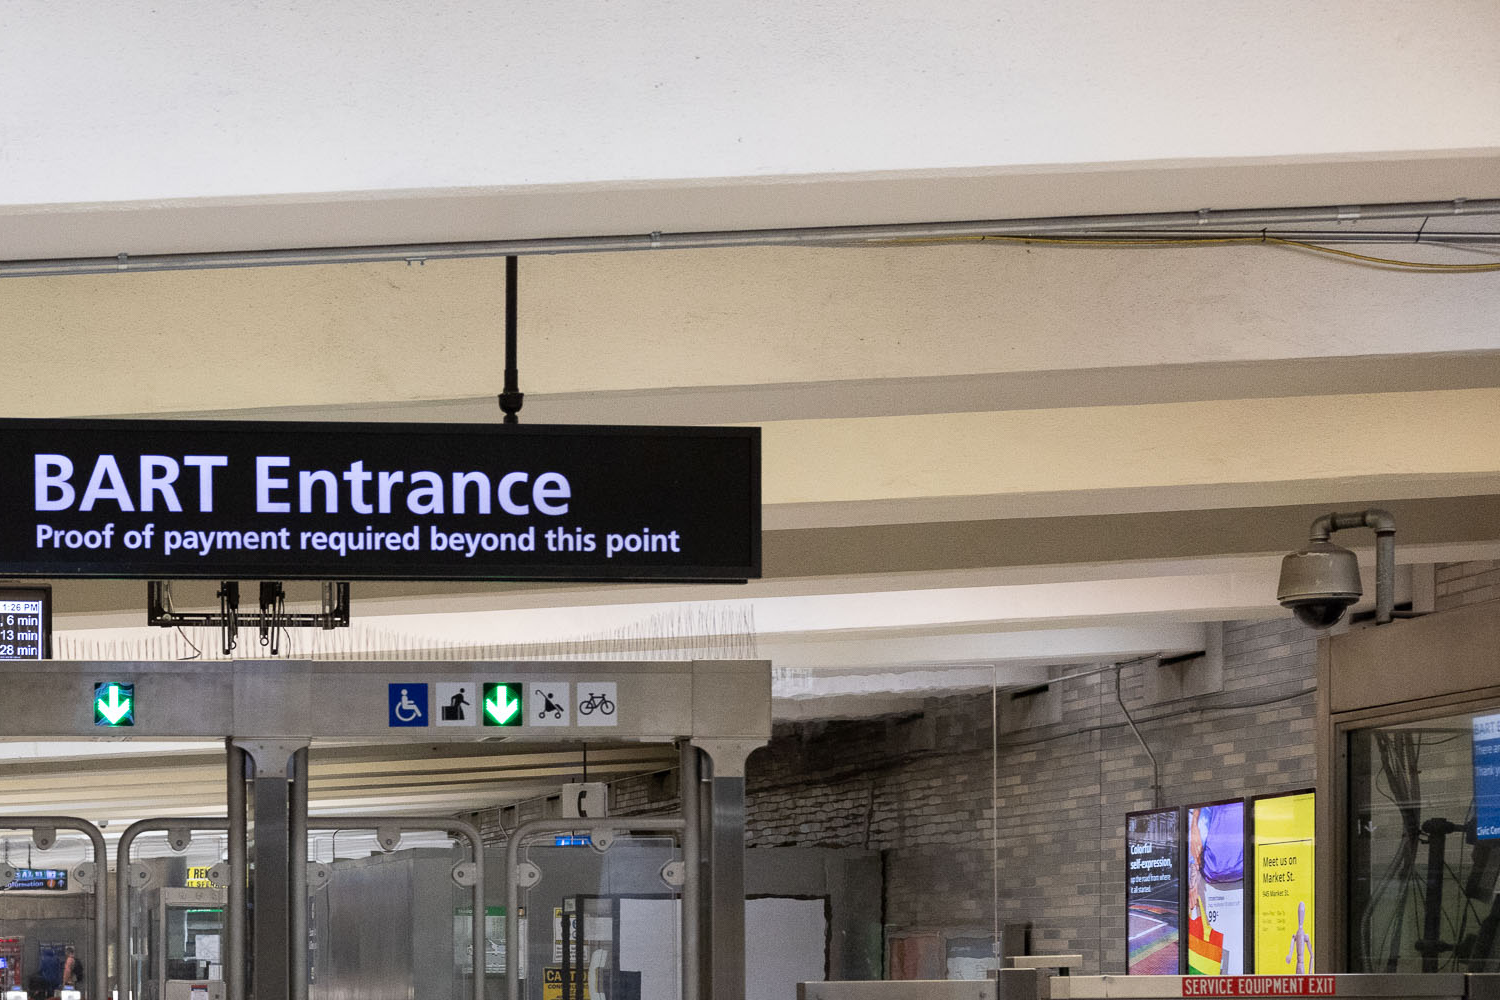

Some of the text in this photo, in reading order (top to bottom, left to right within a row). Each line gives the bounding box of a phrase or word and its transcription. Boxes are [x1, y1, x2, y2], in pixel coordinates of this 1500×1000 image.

[35, 454, 572, 516] BART Entrance
[36, 523, 681, 558] Proof of payment required beyond this point
[2, 603, 38, 612] 1:26 PM
[6, 615, 15, 626] 6
[17, 614, 38, 626] min
[0, 630, 15, 641] 13
[17, 629, 38, 641] min
[0, 644, 15, 656] 28
[17, 644, 38, 656] min
[1131, 842, 1152, 855] Colorful
[1131, 857, 1172, 871] self-expression,
[1263, 856, 1297, 867] Meet us on
[1263, 871, 1295, 883] Market St.
[1185, 977, 1334, 995] SERVICE EQUIPMENT EXIT
